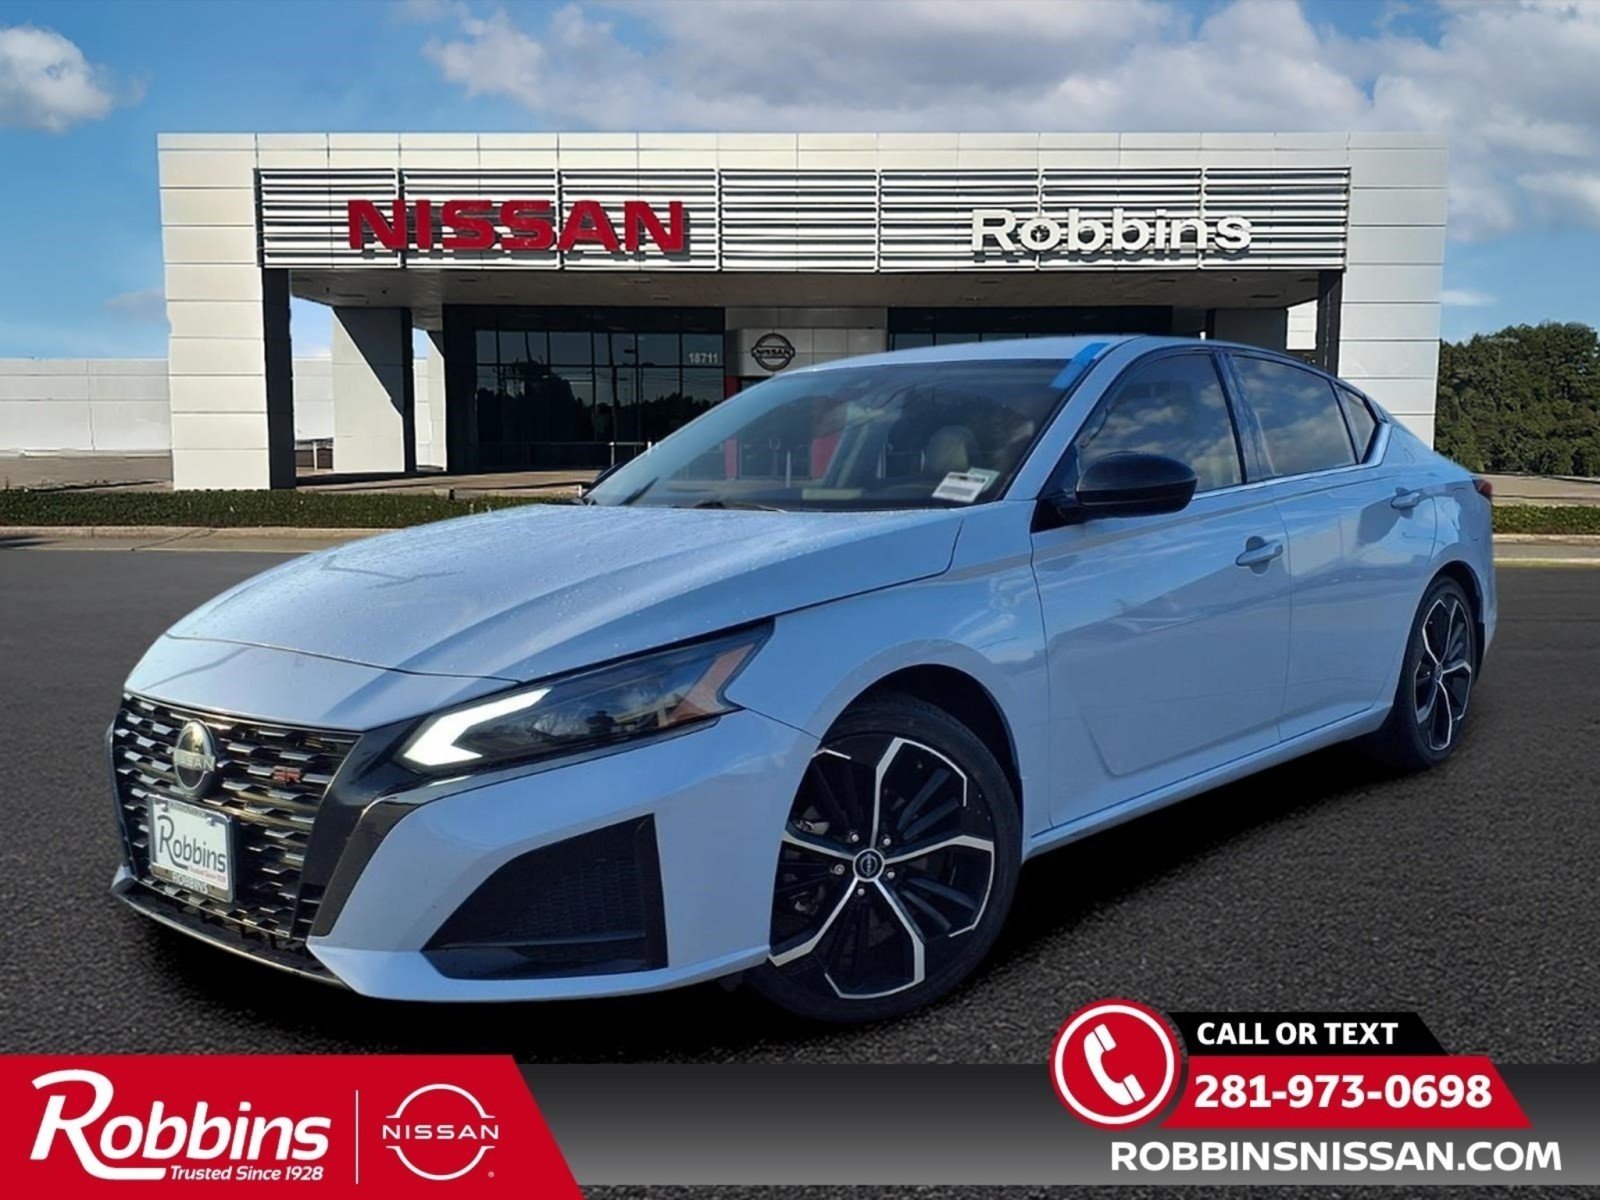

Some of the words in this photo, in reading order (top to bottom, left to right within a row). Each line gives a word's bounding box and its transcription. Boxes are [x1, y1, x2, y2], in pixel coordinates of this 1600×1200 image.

[348, 199, 684, 252] NISSAN
[971, 208, 1253, 252] Robbins
[688, 352, 719, 363] 18711
[754, 347, 792, 358] NISSAN
[157, 814, 227, 874] Robbins
